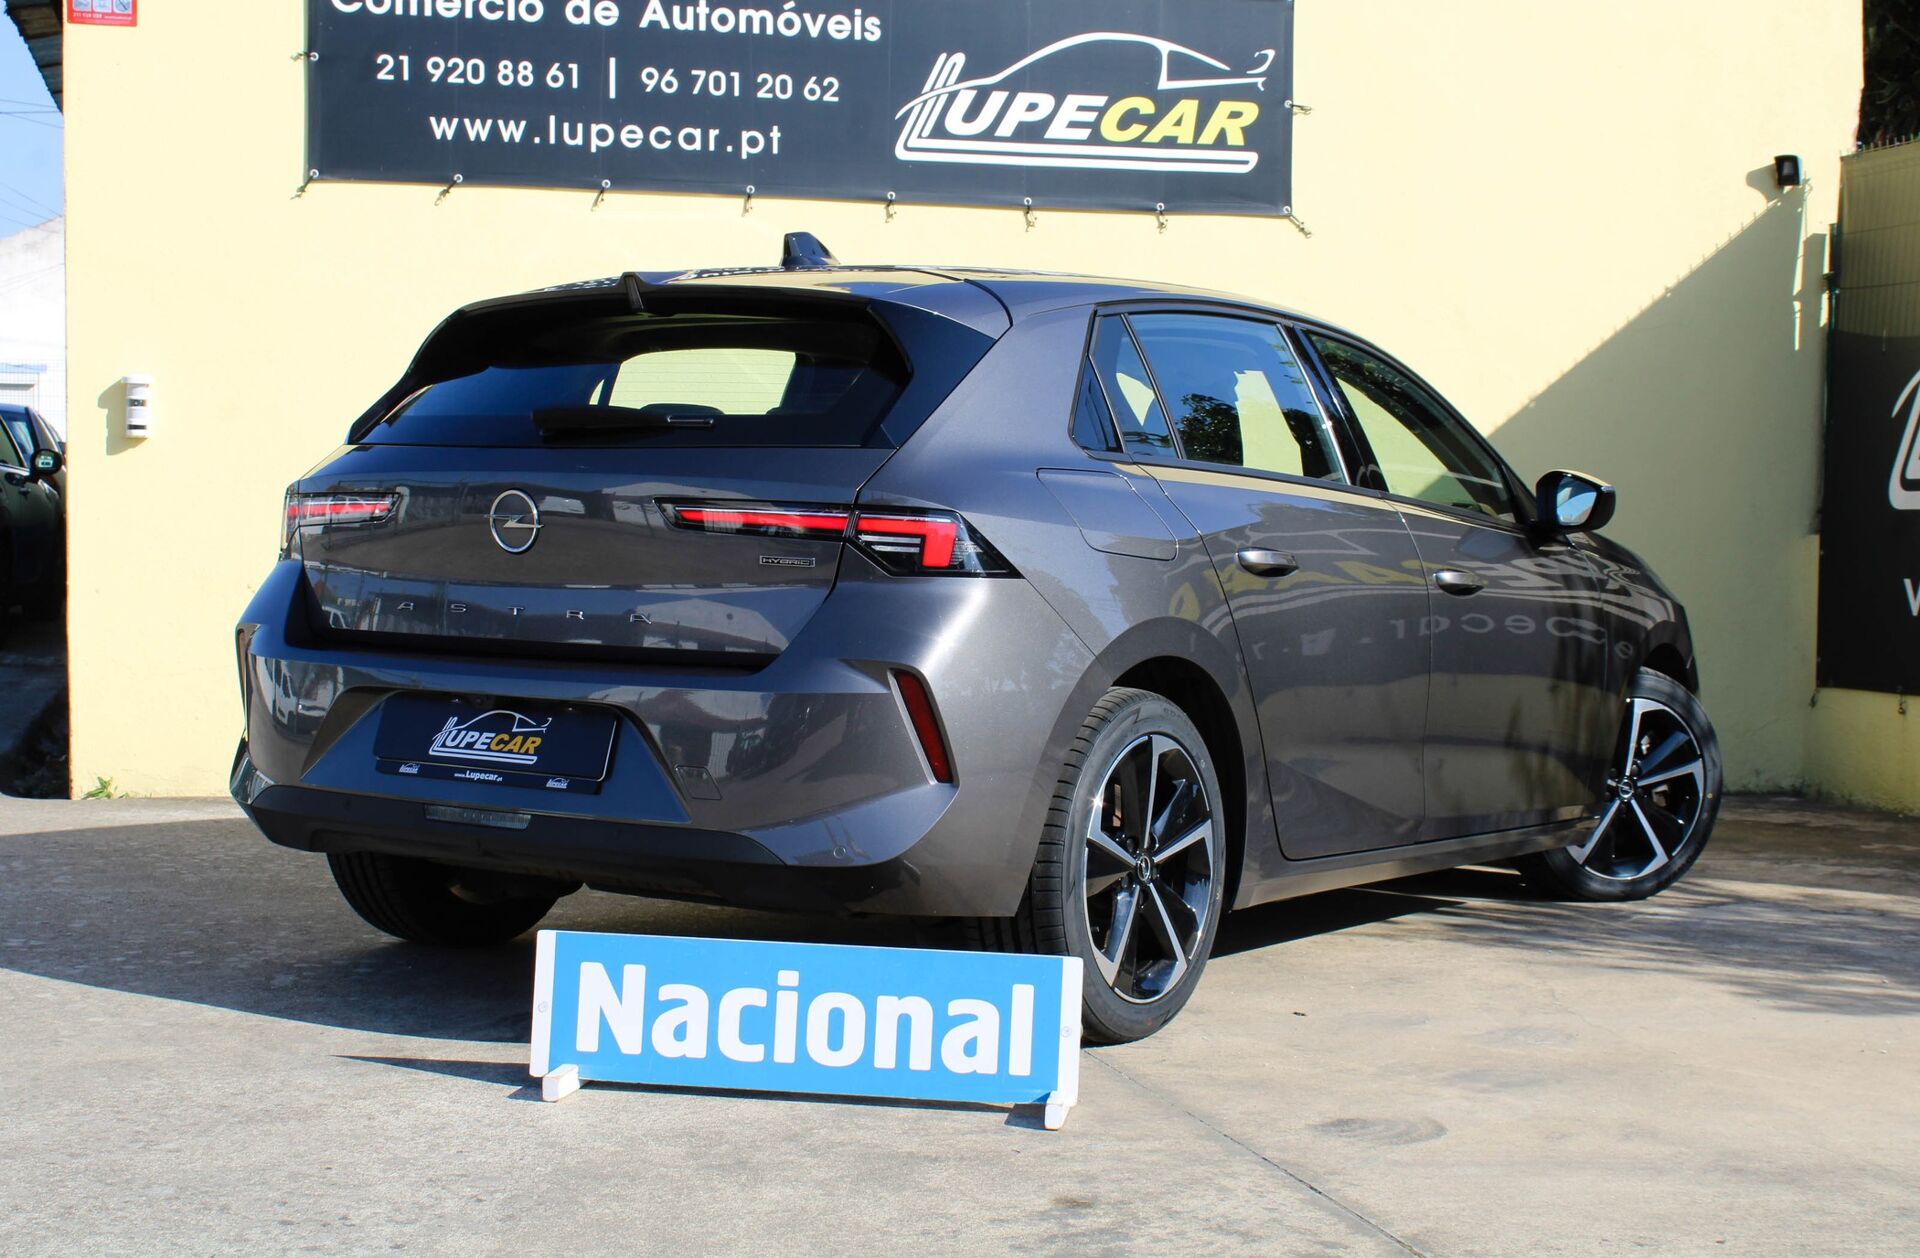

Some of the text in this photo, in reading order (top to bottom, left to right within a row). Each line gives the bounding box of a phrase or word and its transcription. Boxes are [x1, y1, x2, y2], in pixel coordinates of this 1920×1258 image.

[564, 0, 620, 26] de
[638, 0, 882, 41] Automóveis
[376, 54, 840, 102] 21 920 88 61 96 701 20 62
[895, 53, 1258, 173] LUPECAR
[429, 115, 782, 159] www.lupecar.pt
[397, 602, 652, 625] ASTRA
[429, 717, 542, 764] LUPECAR
[575, 961, 1035, 1076] Nacional
